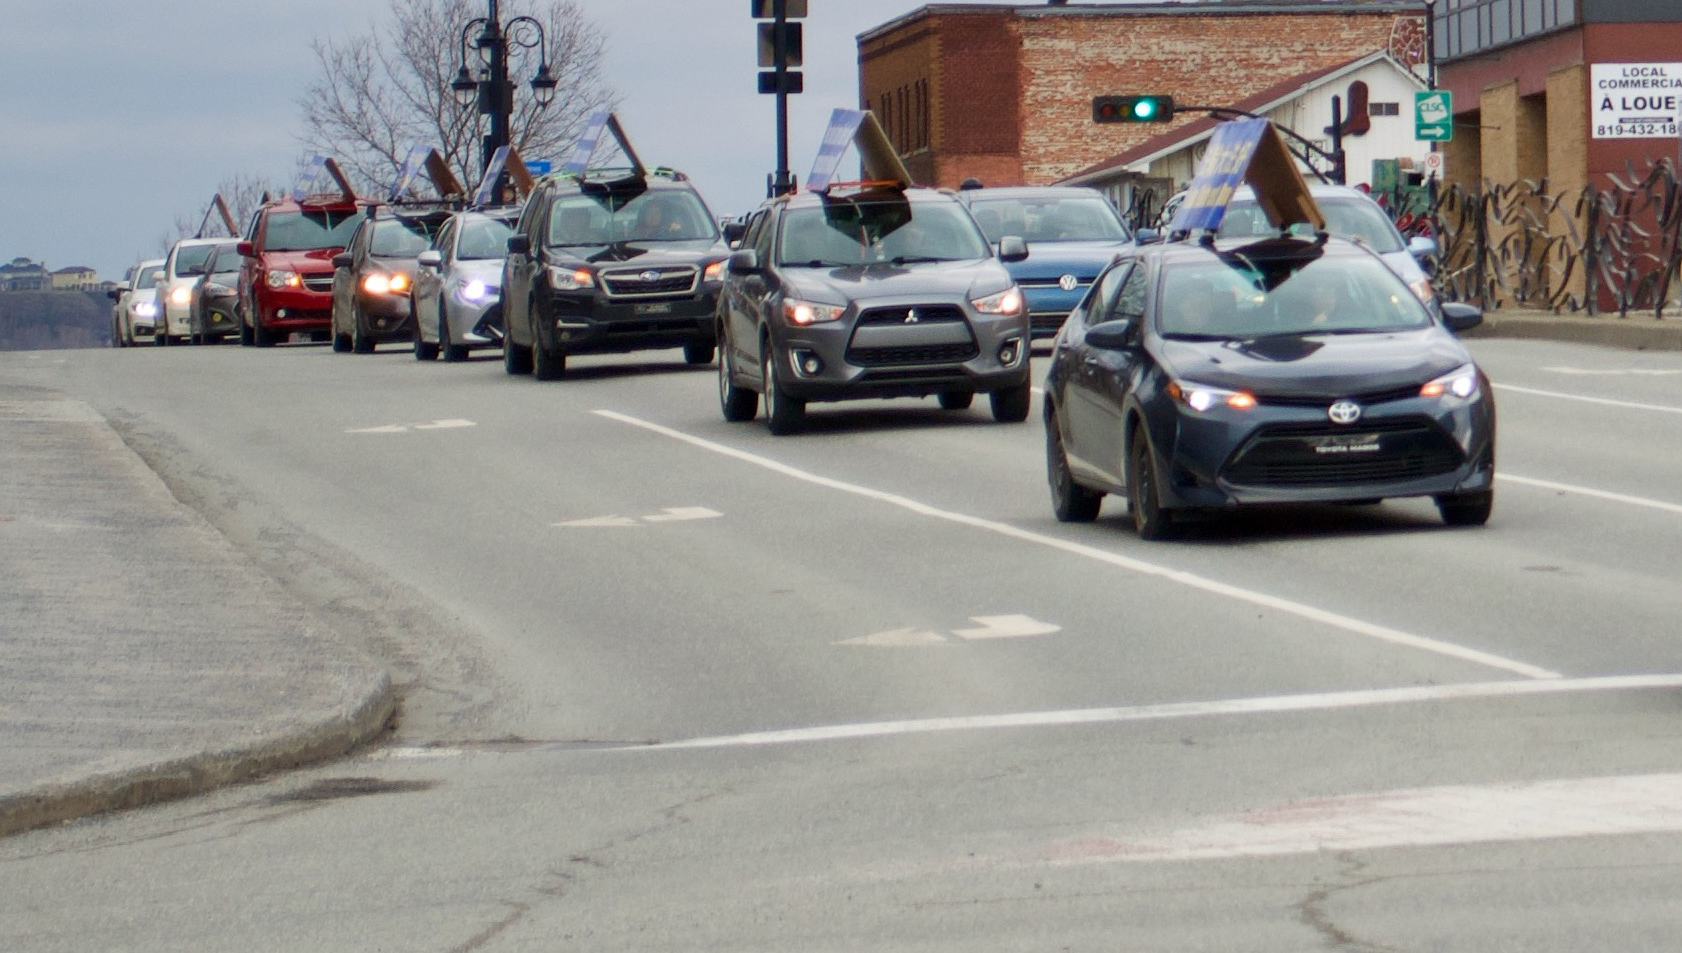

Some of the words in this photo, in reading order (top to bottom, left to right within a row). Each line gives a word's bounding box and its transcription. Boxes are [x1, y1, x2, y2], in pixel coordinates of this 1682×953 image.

[1622, 67, 1668, 77] LOCAL
[1419, 102, 1444, 112] CLSC
[1601, 93, 1614, 111] À
[1621, 96, 1677, 111] LOUE
[1598, 124, 1677, 136] 819-432-18
